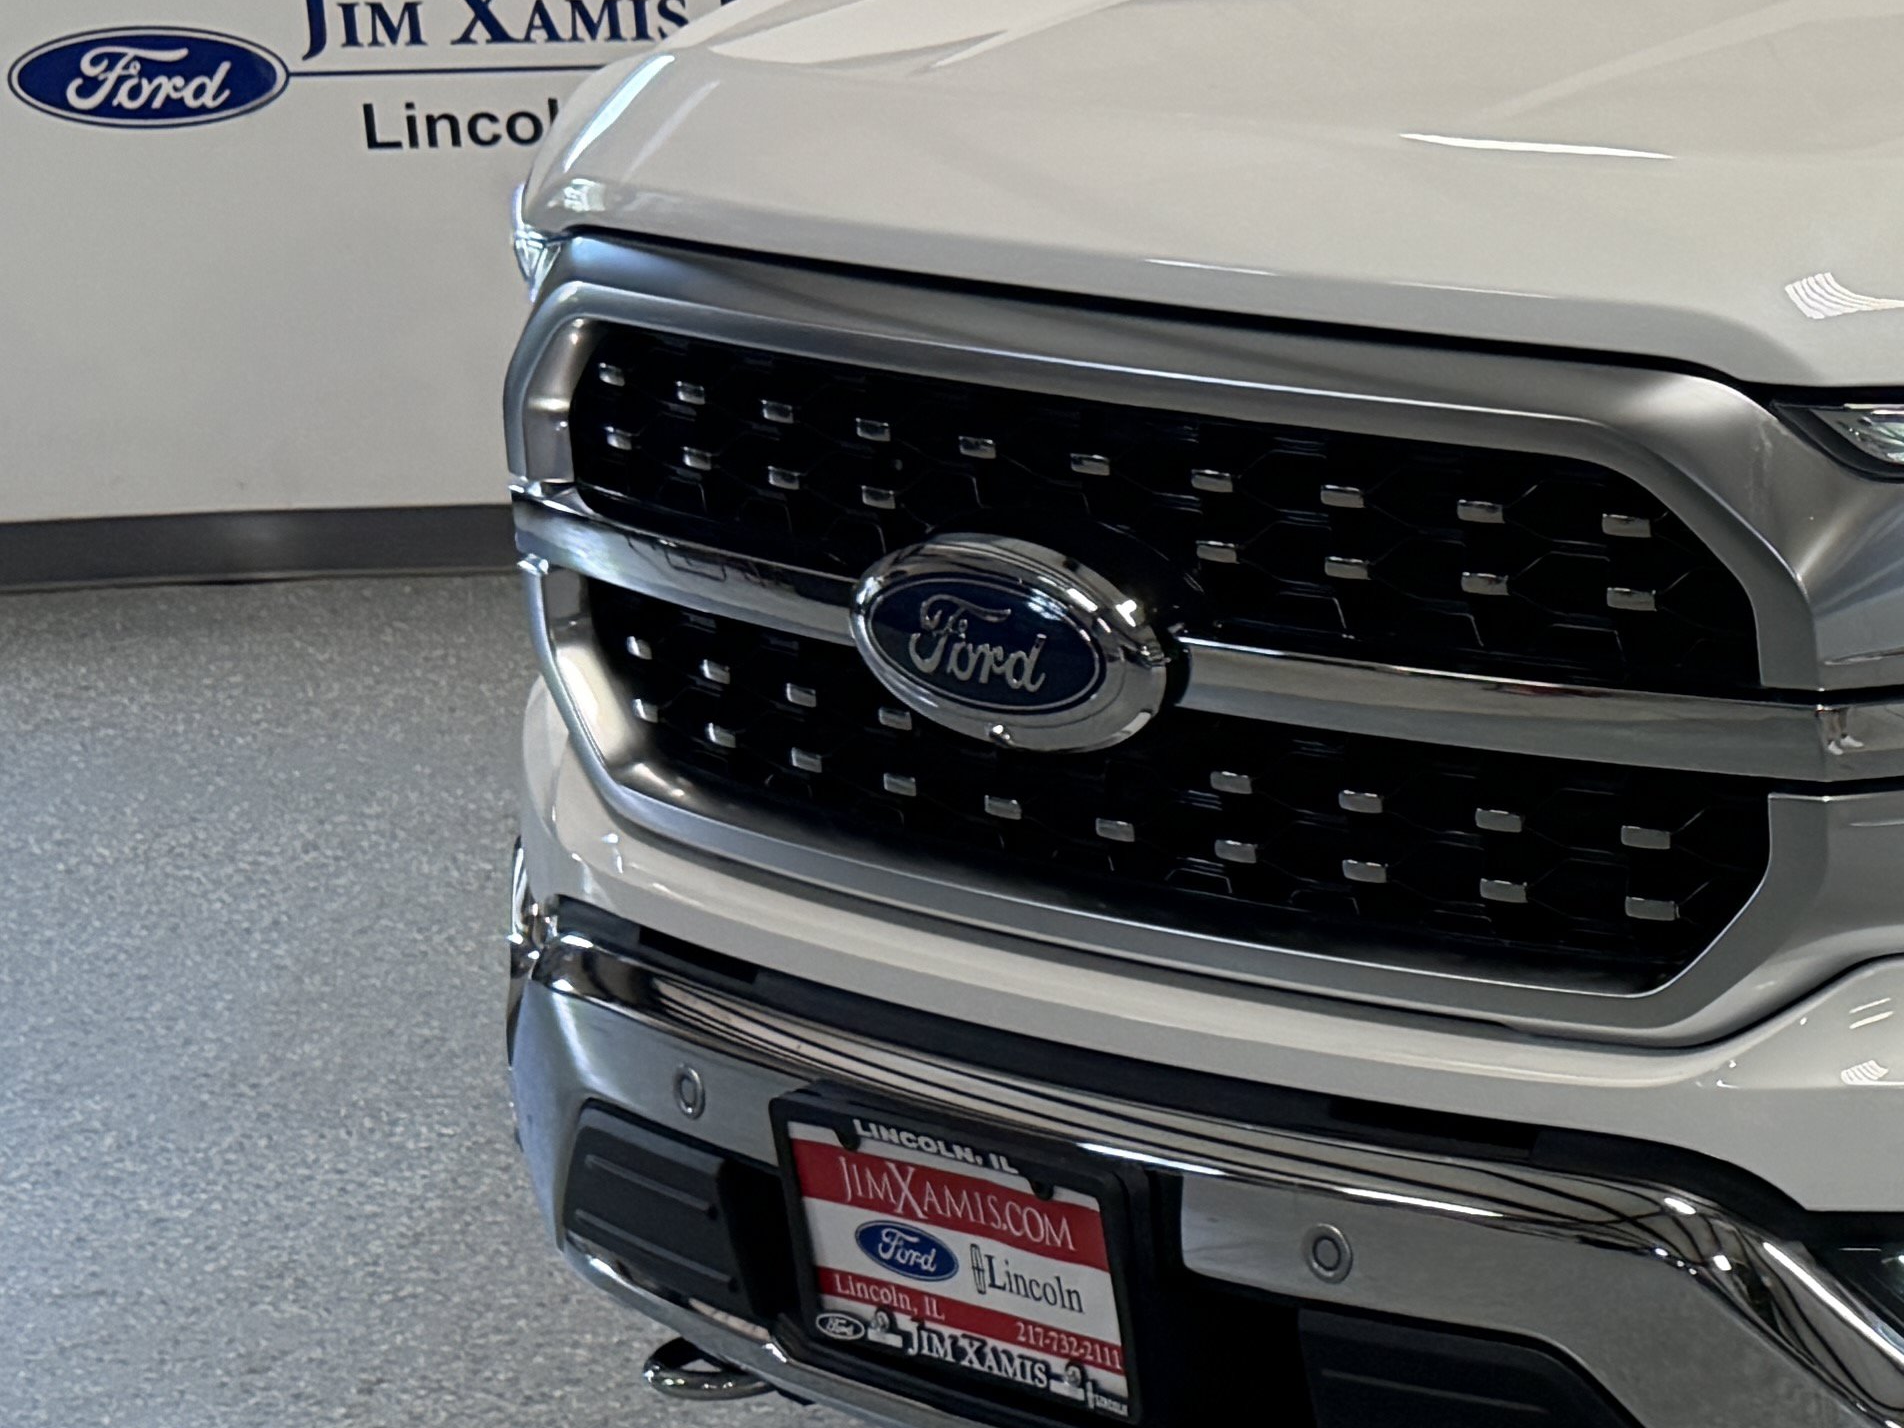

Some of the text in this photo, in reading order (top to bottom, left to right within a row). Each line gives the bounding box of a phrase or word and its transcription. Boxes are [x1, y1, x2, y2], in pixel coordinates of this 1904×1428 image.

[64, 45, 231, 112] Ford
[908, 593, 1047, 693] Ford
[852, 1118, 1019, 1174] LINCOLN, IL
[837, 1156, 1077, 1251] JIMXAMIS.COM
[877, 1228, 938, 1274] Ford
[834, 1275, 946, 1321] Lincoln, IL
[984, 1253, 1085, 1314] Lincoln
[908, 1322, 1049, 1389] JIM XAMIS
[1016, 1321, 1124, 1370] 217-732-2111
